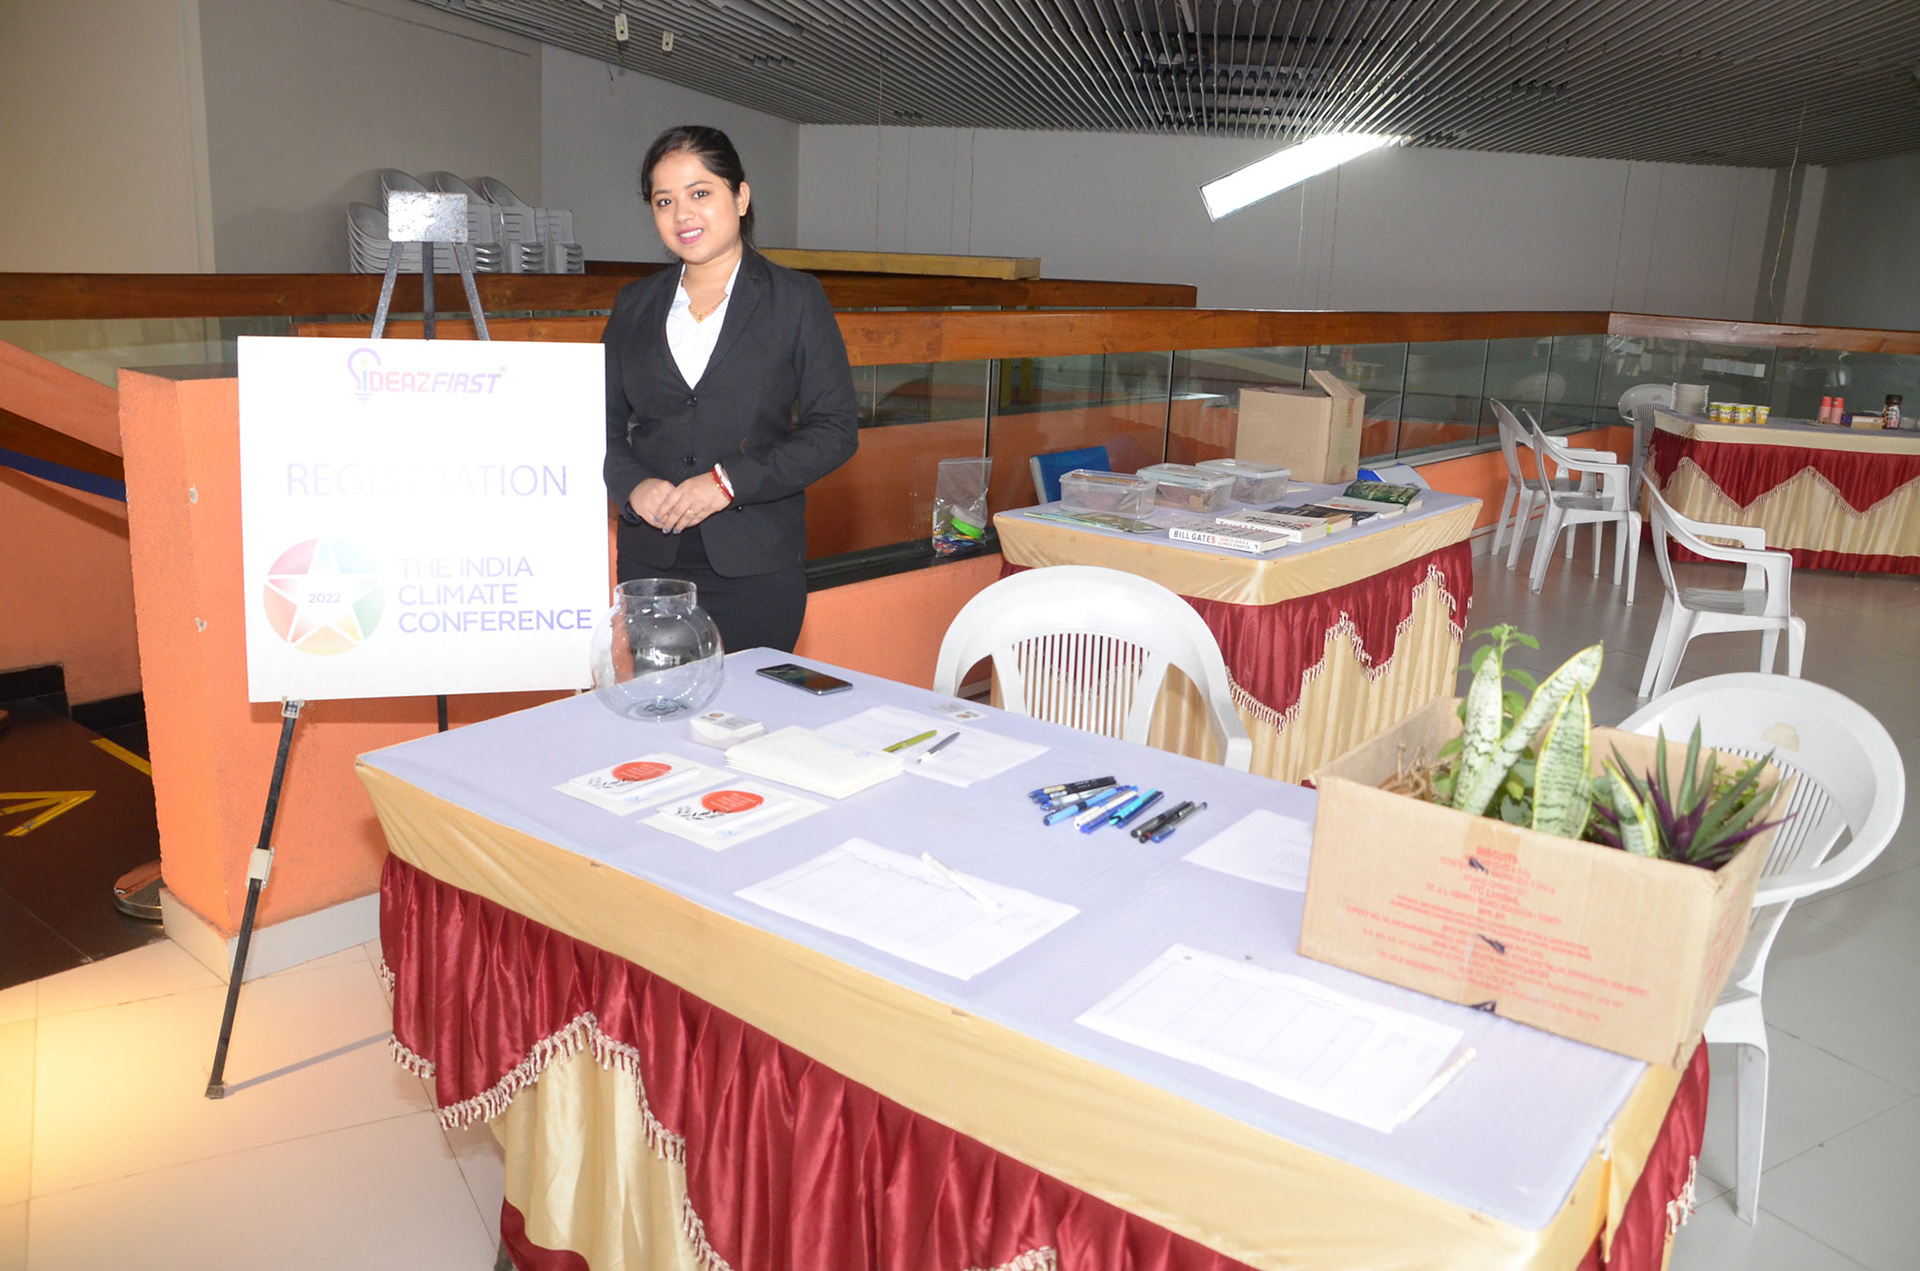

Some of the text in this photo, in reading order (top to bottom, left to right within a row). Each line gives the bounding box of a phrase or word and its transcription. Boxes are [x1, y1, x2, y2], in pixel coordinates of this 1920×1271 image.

[1174, 530, 1216, 544] BILL GATES
[398, 556, 534, 578] THE INDIA
[308, 593, 342, 604] 2022
[398, 583, 518, 606] CLIMATE
[398, 608, 592, 634] CONFERENCE
